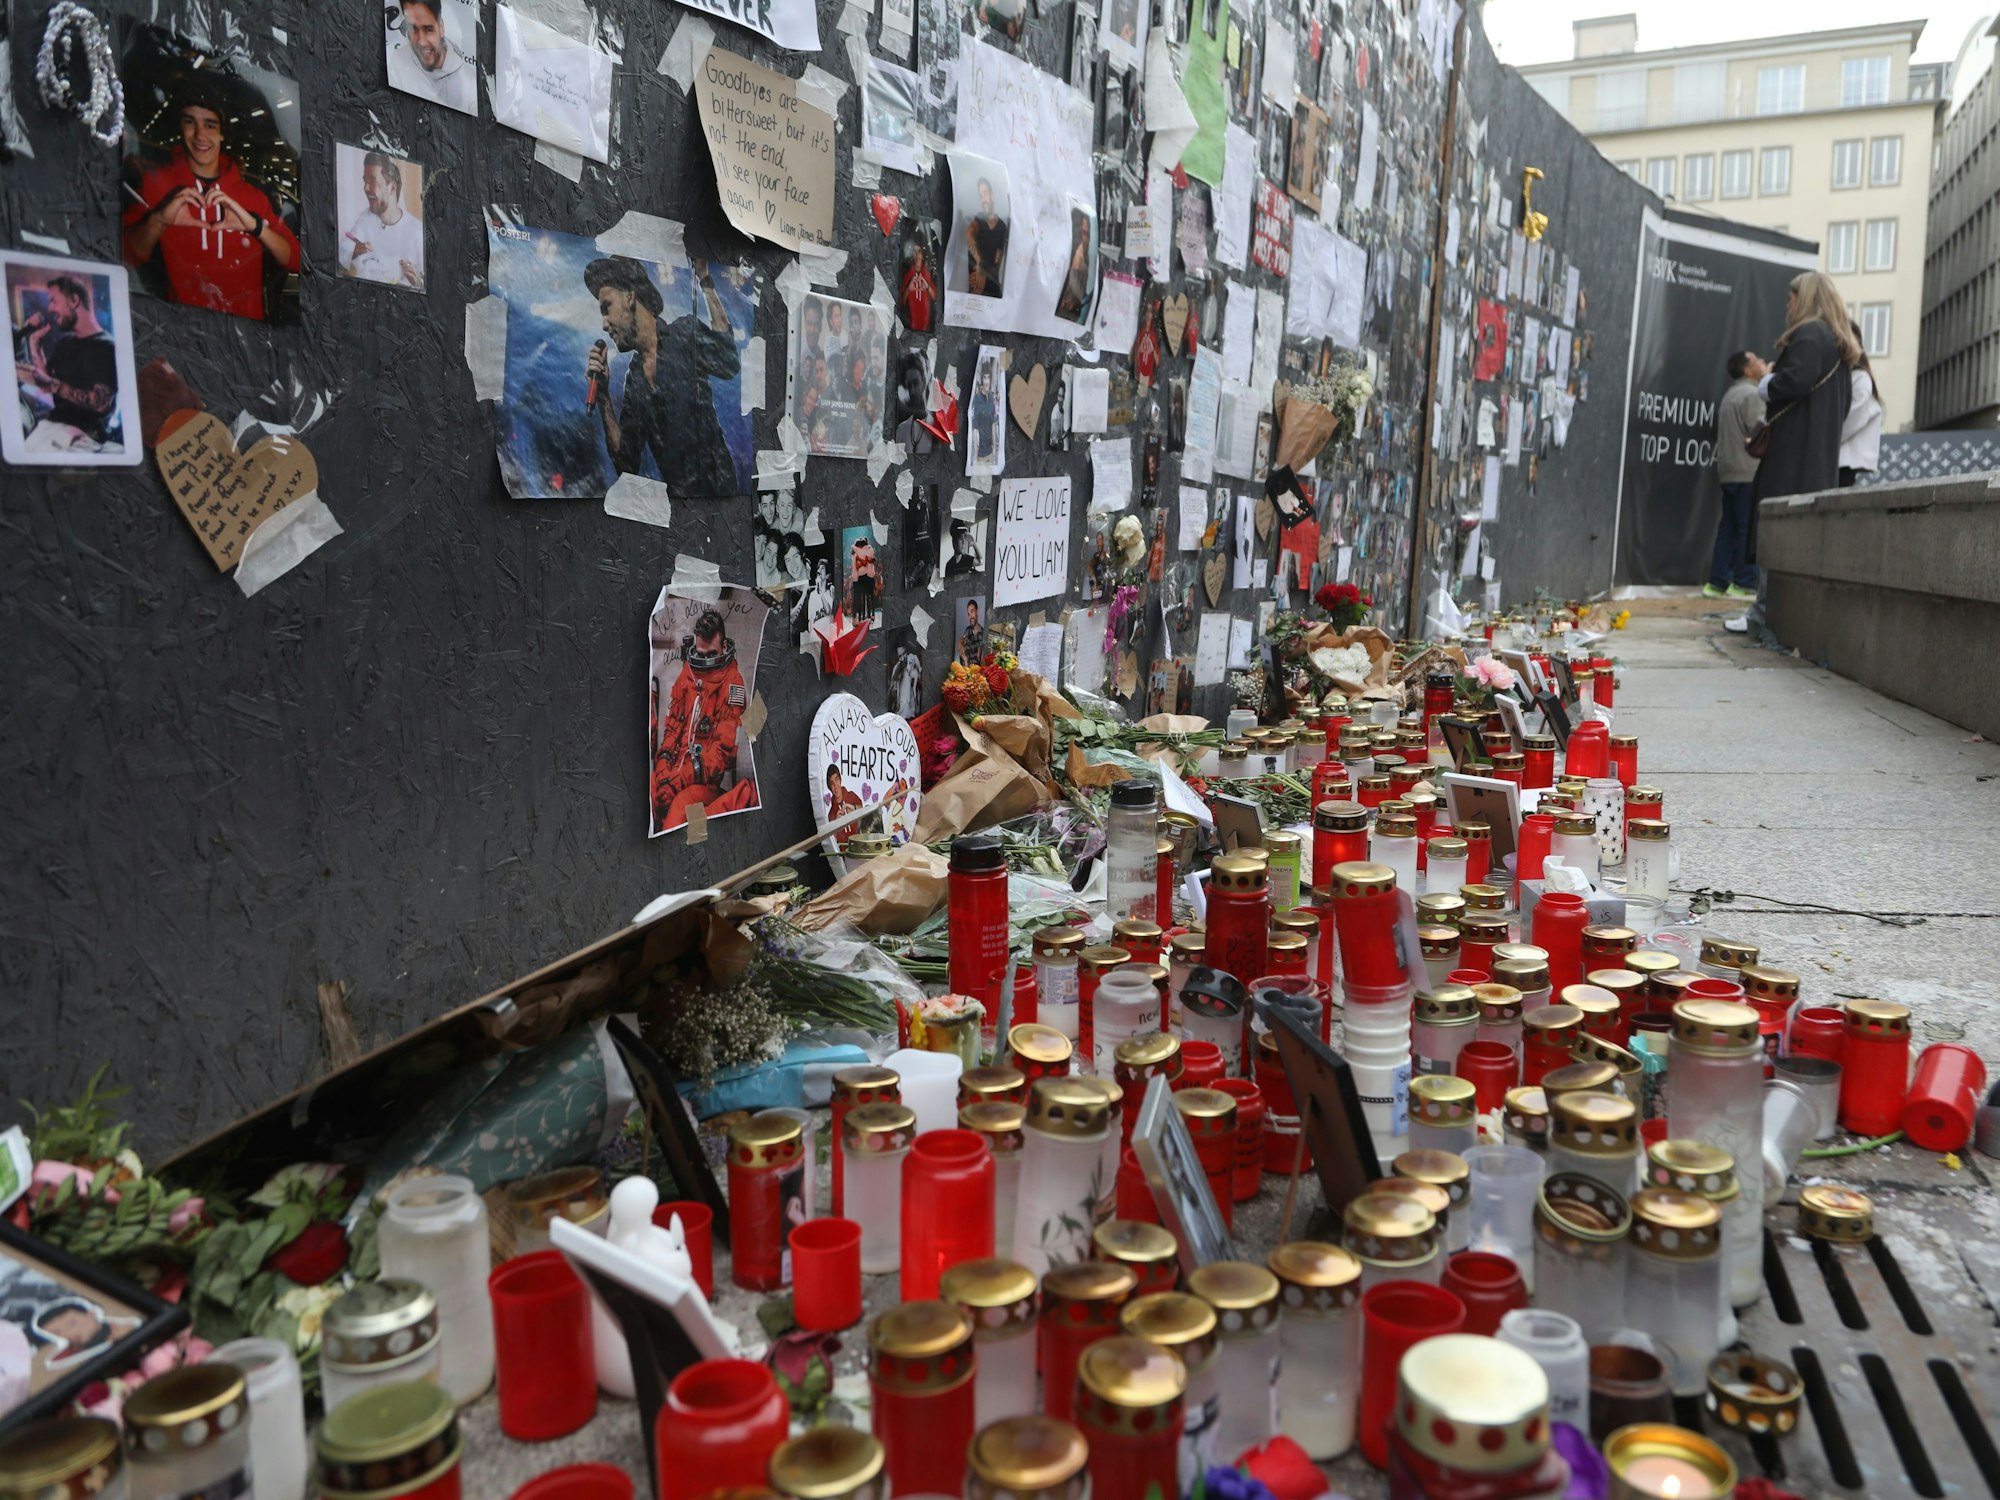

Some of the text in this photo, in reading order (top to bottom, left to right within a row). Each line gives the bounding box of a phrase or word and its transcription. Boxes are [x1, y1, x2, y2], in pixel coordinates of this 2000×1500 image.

[706, 54, 797, 113] Goodbyes are
[708, 123, 727, 144] not
[736, 129, 756, 157] the
[787, 118, 805, 141] but
[812, 130, 829, 152] it's
[733, 164, 750, 184] see
[755, 171, 780, 199] your
[784, 176, 809, 205] face
[780, 218, 796, 237] Liam
[797, 223, 815, 242] James
[1638, 390, 1715, 428] PREMIUM
[169, 440, 193, 457] hope
[191, 444, 209, 461] well
[1641, 433, 1670, 463] TOP
[207, 502, 224, 517] the
[1003, 488, 1068, 523] WE LOVE
[998, 540, 1064, 583] YOU LIAM
[823, 708, 868, 757] ALWAYS
[881, 726, 893, 746] IN
[896, 728, 915, 763] OUR
[841, 744, 895, 782] HEARTS
